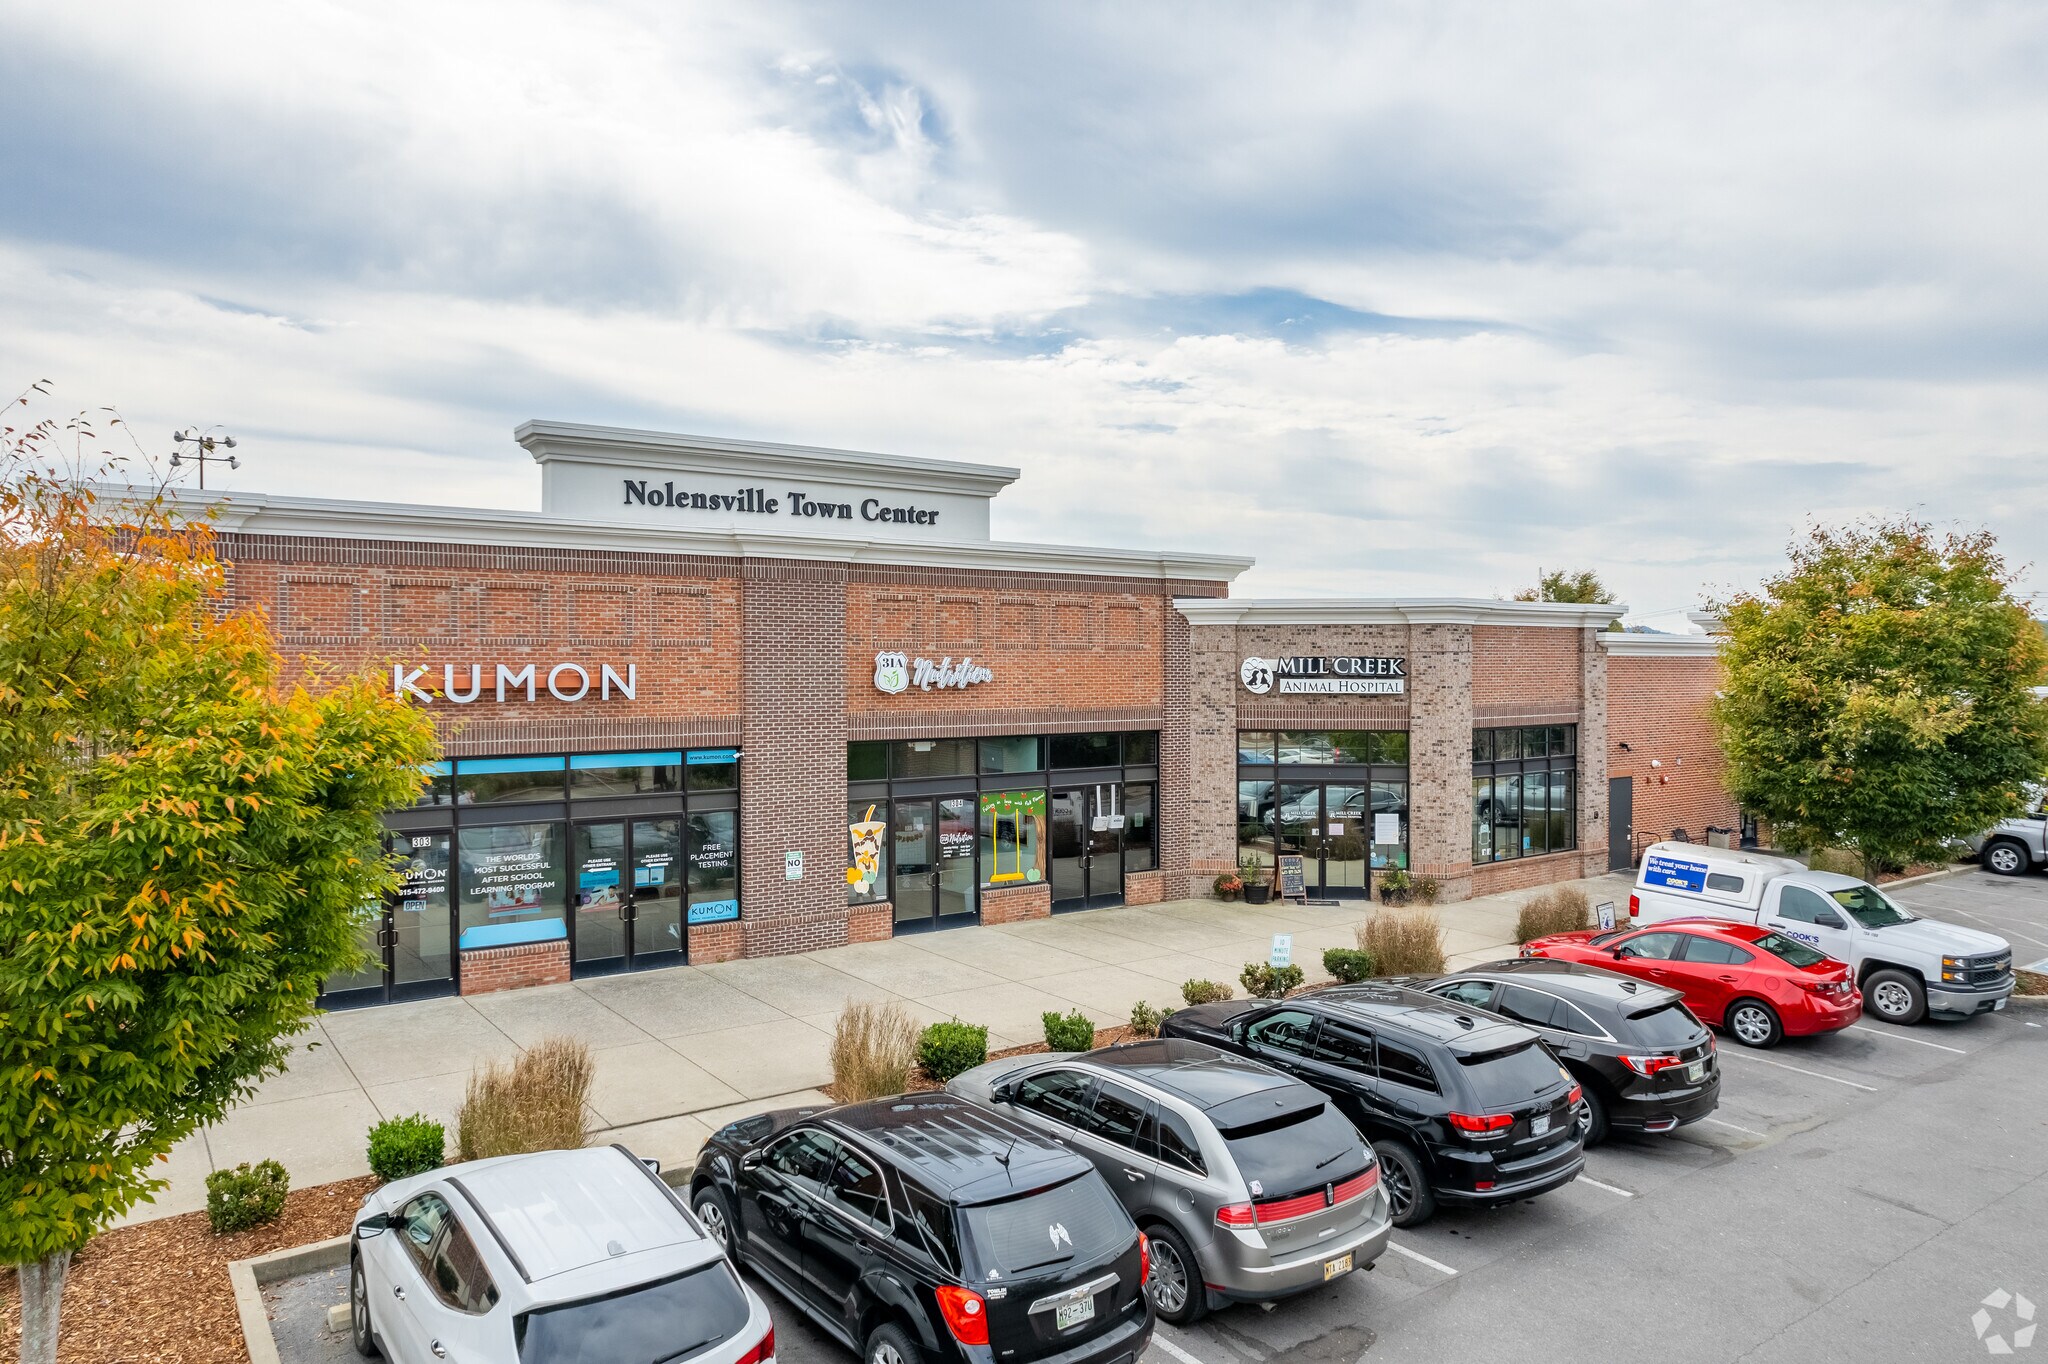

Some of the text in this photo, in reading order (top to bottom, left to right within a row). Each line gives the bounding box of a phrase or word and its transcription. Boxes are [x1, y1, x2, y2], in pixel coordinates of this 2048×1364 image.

[624, 480, 940, 525] Nolensville Town Center
[882, 658, 903, 668] 31A
[1277, 657, 1405, 676] MILL CREEK
[913, 656, 993, 692] Nutrition
[394, 663, 636, 704] KUMON
[1284, 681, 1401, 692] ANIMAL HOSPITAL
[689, 753, 735, 761] www.kumon.com
[413, 837, 431, 847] 303
[702, 844, 721, 852] FREE
[503, 853, 541, 862] WORLD'S
[690, 851, 734, 861] PLACEMENT
[474, 862, 551, 874] MOST SUCCESSFUL
[698, 860, 728, 869] TESTING
[787, 859, 801, 868] NO
[1649, 857, 1659, 865] We
[1658, 859, 1674, 868] treat
[398, 868, 447, 880] UMON
[1647, 865, 1662, 873] with
[481, 873, 544, 884] AFTER SCHOOL
[470, 881, 555, 895] LEARNING PROGRAM
[405, 901, 425, 910] OPEN
[692, 903, 732, 915] KUMON
[1786, 930, 1819, 943] COOK'S
